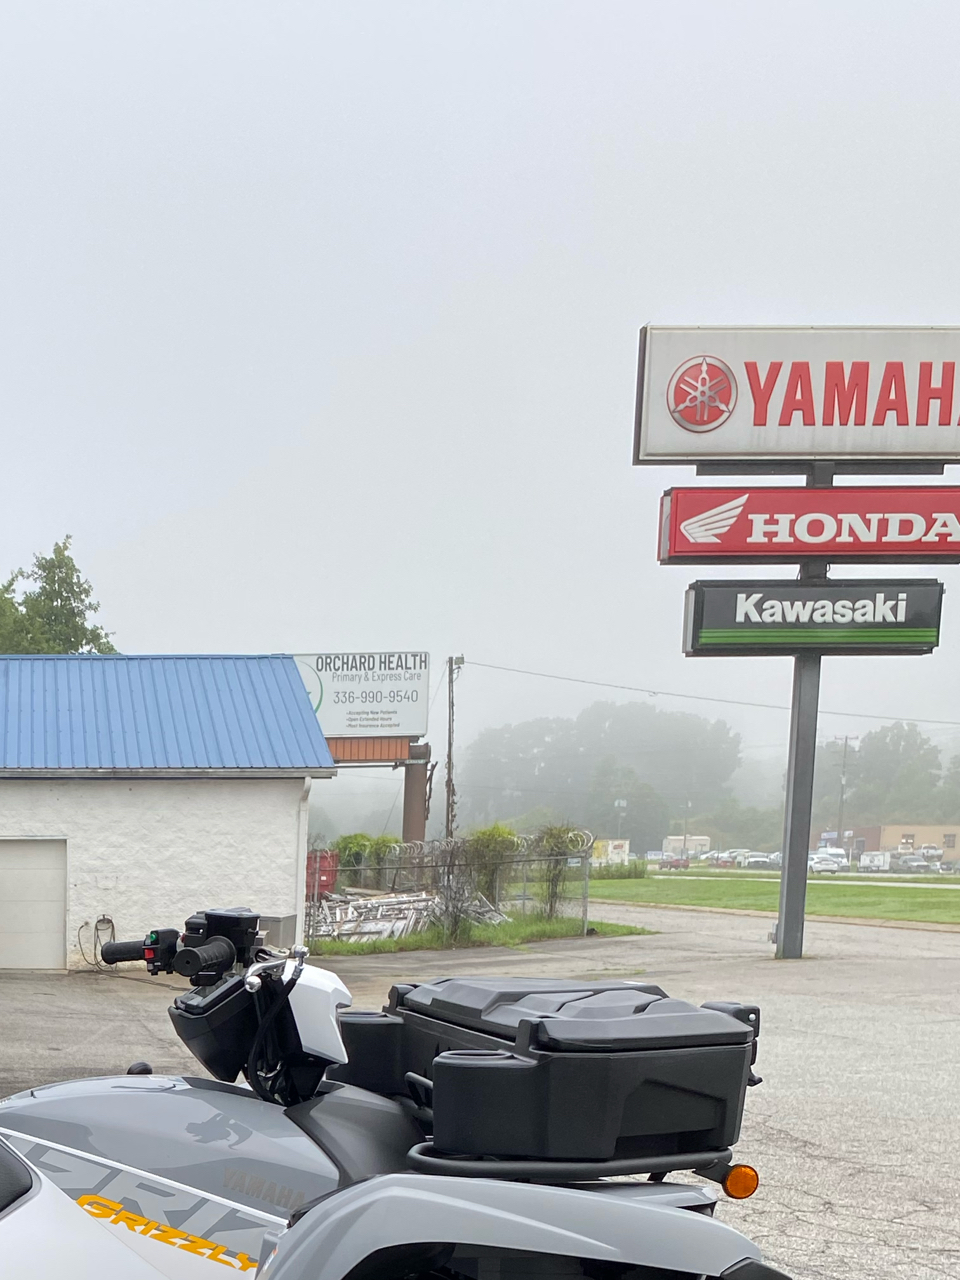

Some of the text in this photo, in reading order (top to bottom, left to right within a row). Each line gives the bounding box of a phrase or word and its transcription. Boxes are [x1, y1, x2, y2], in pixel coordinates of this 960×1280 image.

[744, 361, 960, 427] YAMAH
[746, 513, 960, 543] HONDA
[735, 593, 908, 624] Kawasaki
[316, 654, 427, 672] ORCHARD HEALTH
[332, 671, 422, 684] Primary & Express Care
[333, 690, 419, 704] 336-990-9540
[222, 1166, 307, 1211] YAMAHA
[76, 1194, 259, 1272] GRIZZLY
